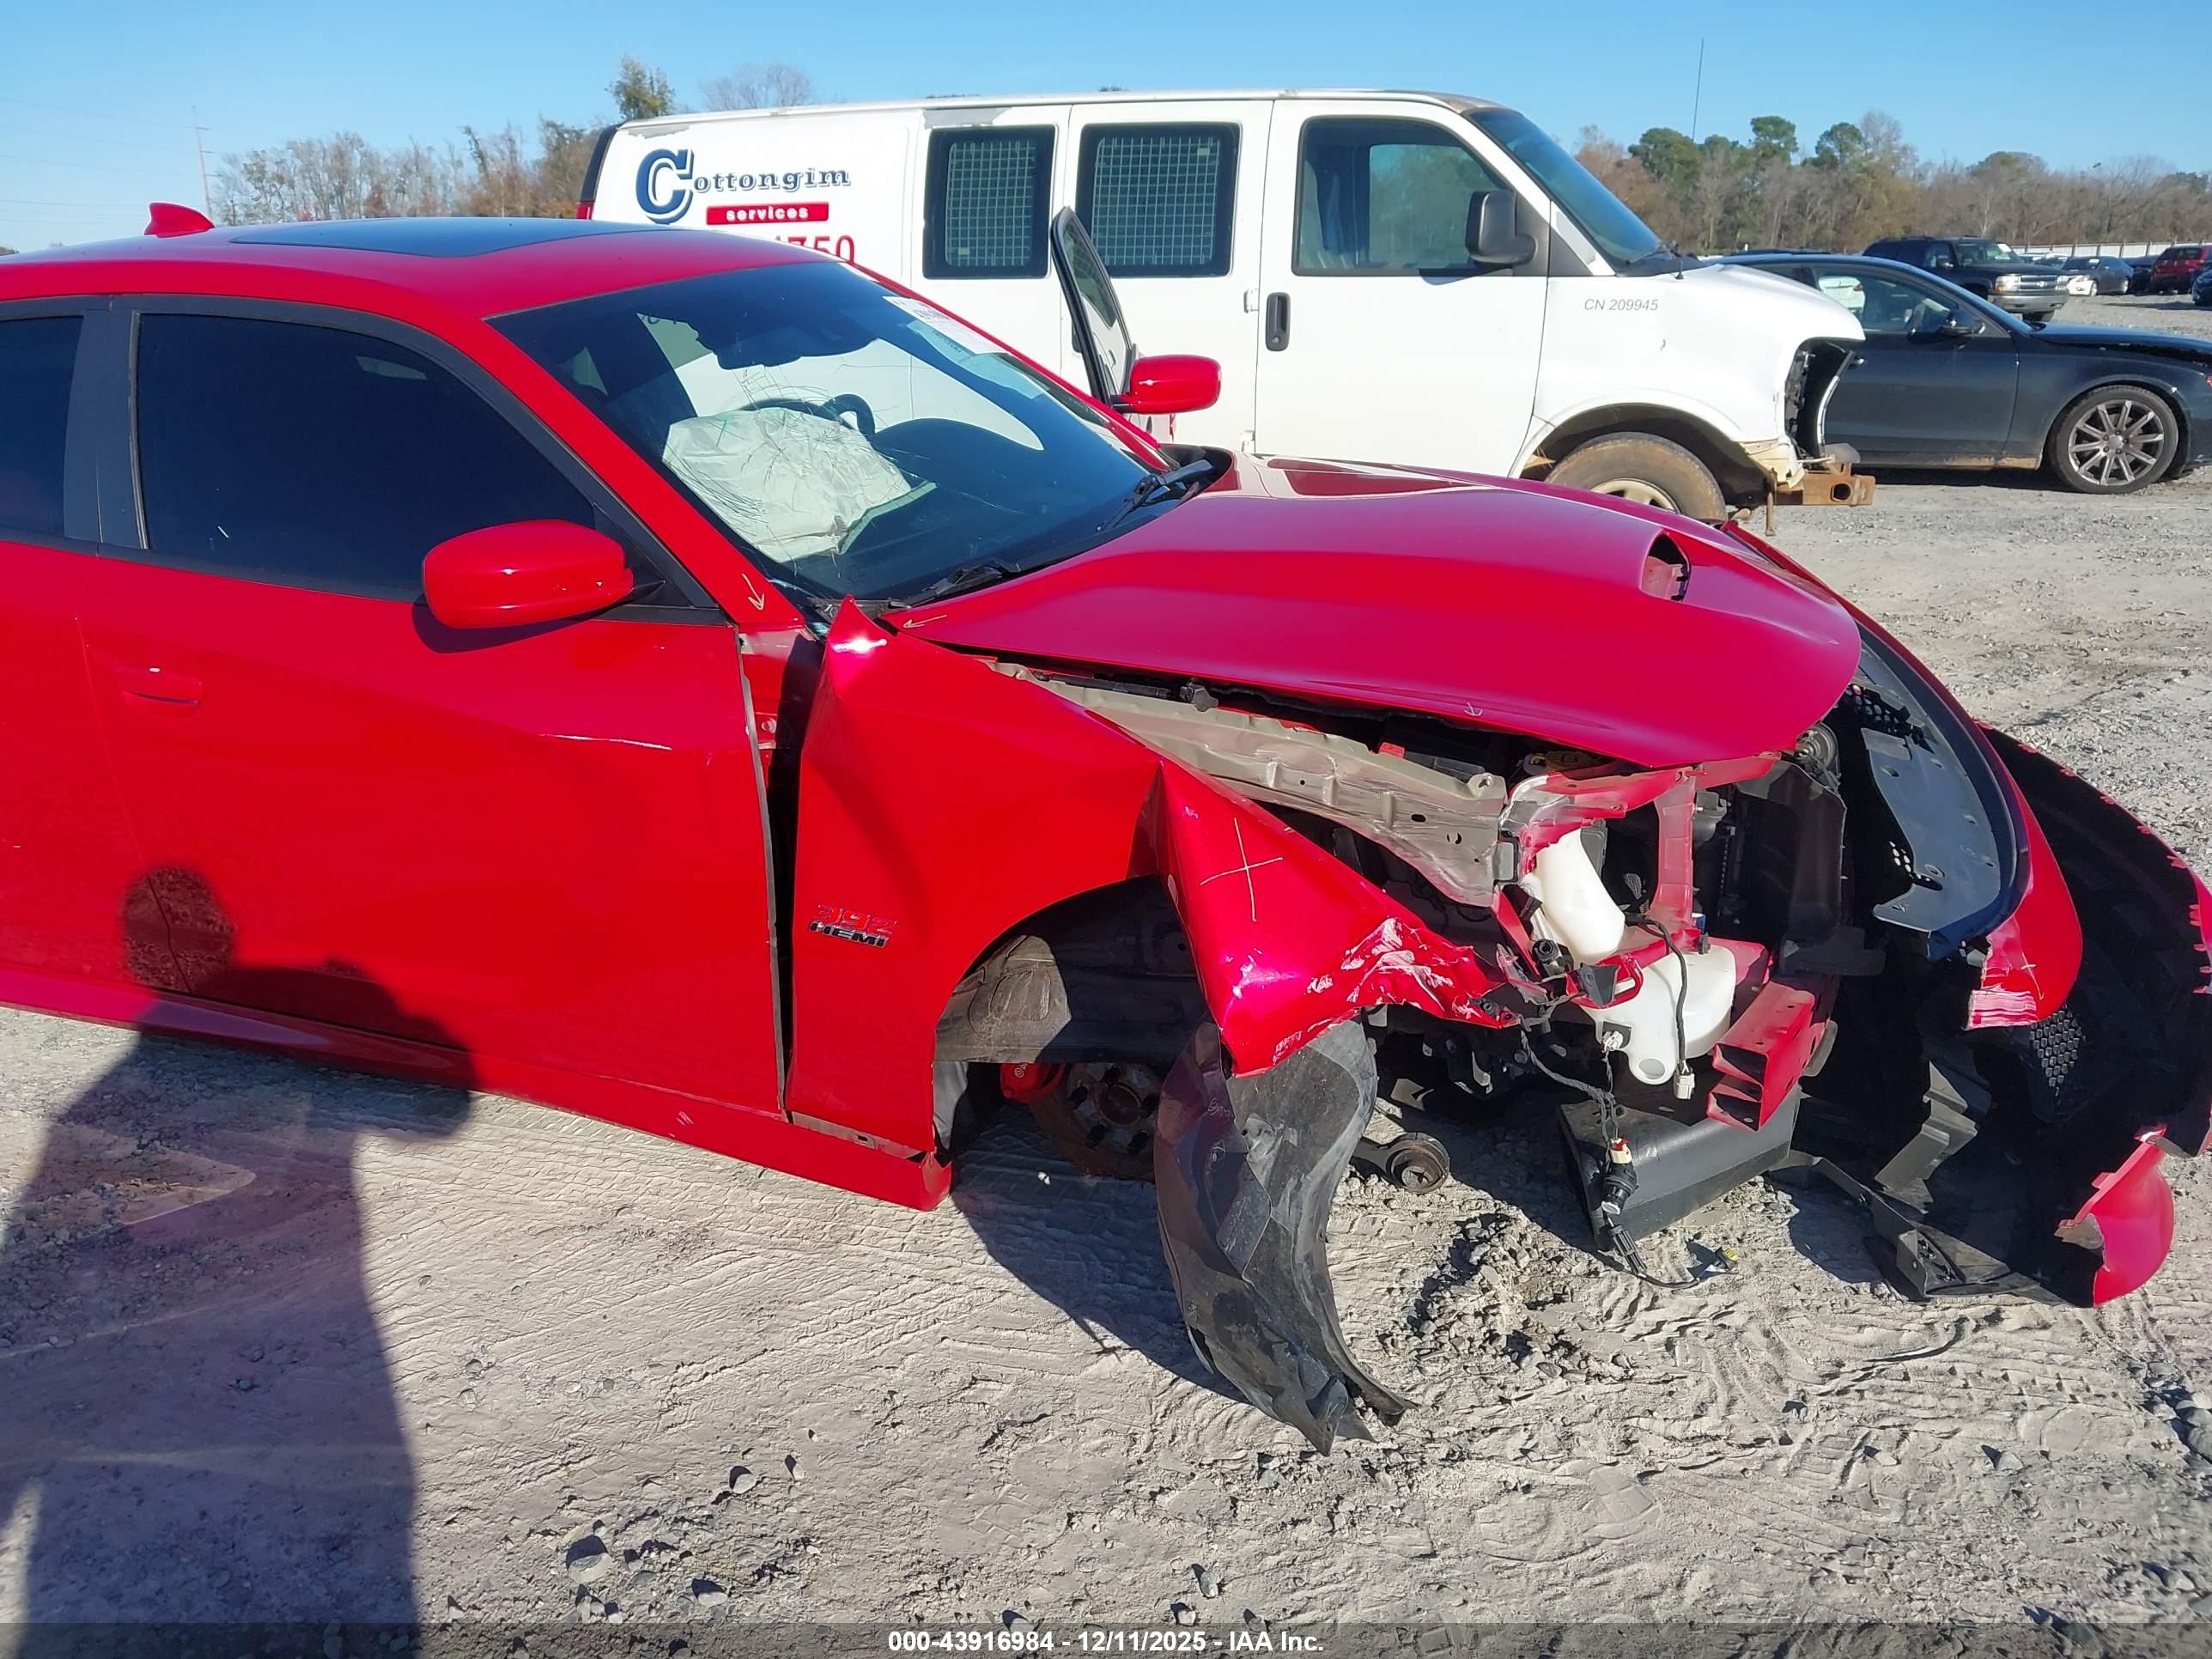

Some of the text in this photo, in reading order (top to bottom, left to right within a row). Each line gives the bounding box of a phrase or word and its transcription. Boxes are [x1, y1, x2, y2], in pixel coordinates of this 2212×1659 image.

[635, 149, 851, 225] Cottongim
[726, 206, 809, 222] services
[1584, 298, 1659, 311] CN 209945
[809, 920, 890, 948] HEMI
